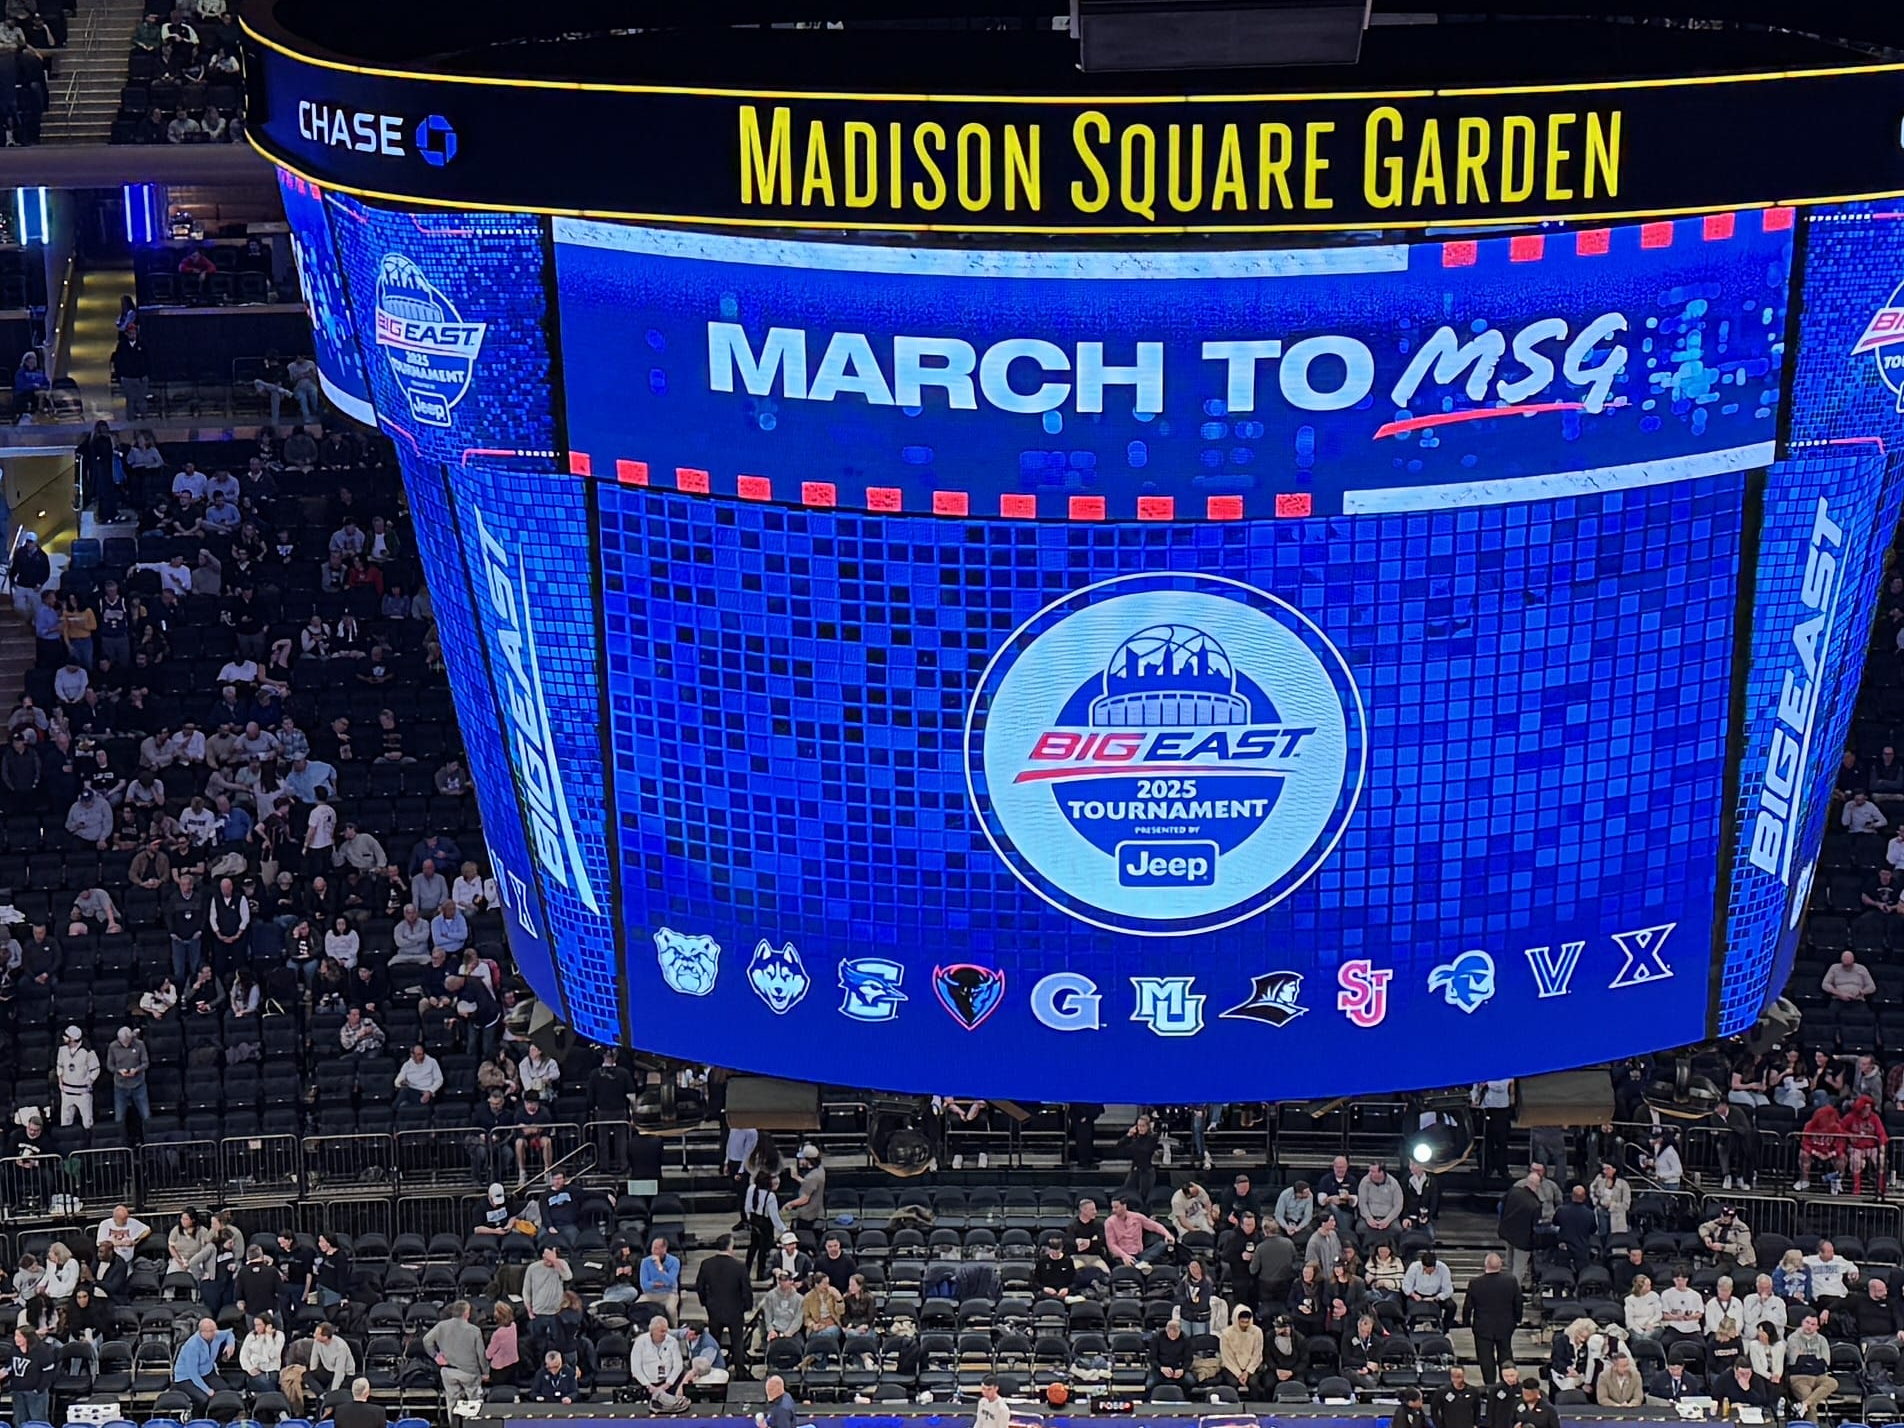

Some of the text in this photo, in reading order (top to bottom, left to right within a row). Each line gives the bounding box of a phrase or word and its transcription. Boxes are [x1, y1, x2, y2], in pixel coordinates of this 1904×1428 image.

[298, 100, 406, 157] CHASE
[405, 323, 479, 347] EAST
[707, 311, 1630, 415] MARCH TO MSG
[1748, 495, 1843, 876] BIG EAST
[1027, 727, 1318, 763] BIG EAST
[1135, 779, 1197, 799] 2025
[1067, 798, 1270, 823] TOURNAMENT
[1134, 826, 1184, 836] PRESENTED
[1125, 851, 1209, 883] Jeep
